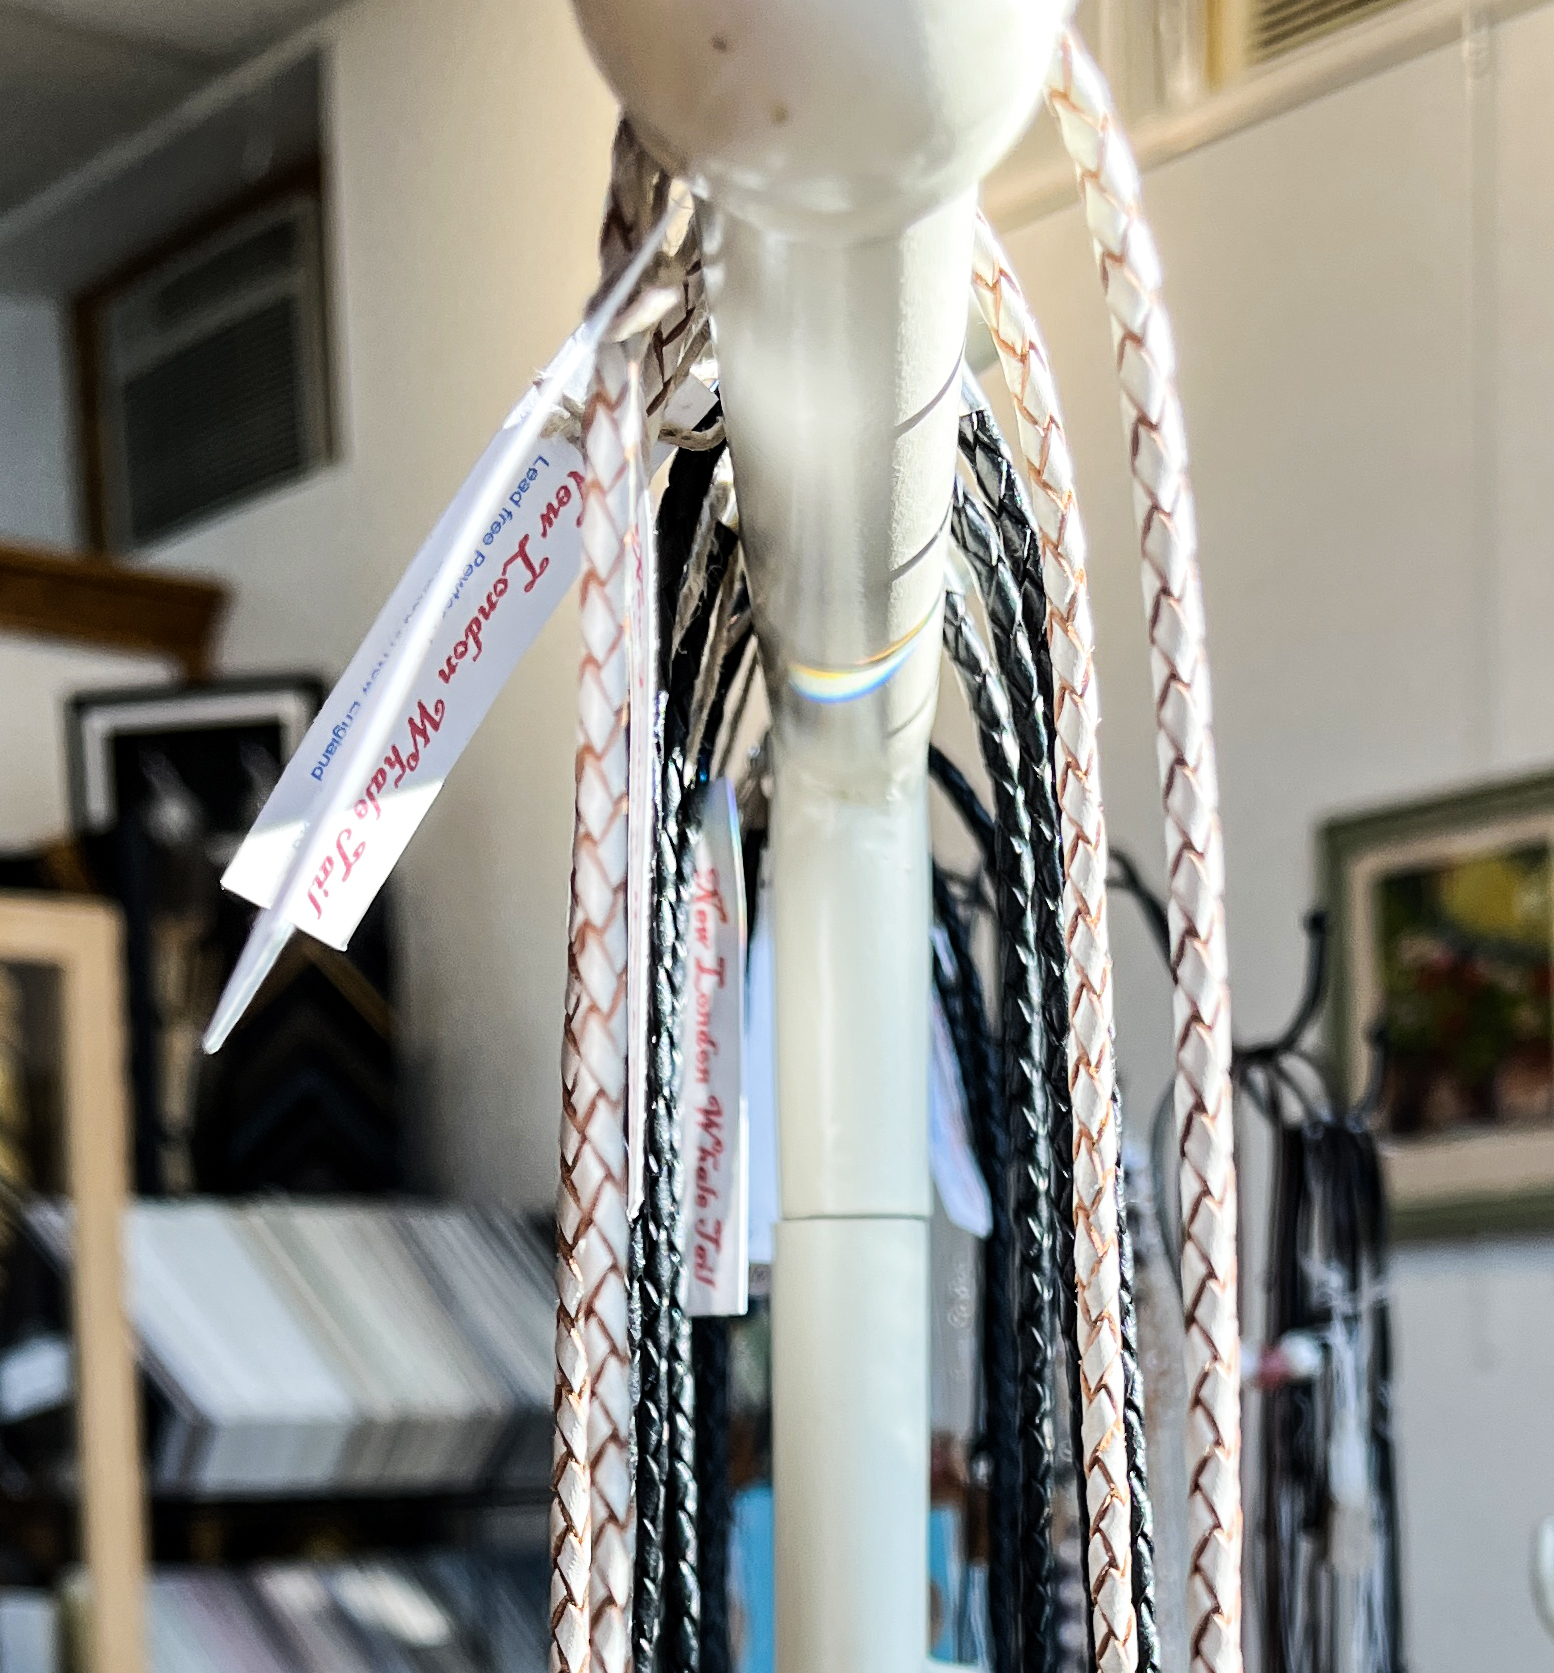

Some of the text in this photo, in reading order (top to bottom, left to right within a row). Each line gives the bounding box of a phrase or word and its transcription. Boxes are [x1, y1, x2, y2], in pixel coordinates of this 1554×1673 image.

[482, 507, 514, 546] free
[509, 454, 550, 508] Lead
[438, 533, 550, 684] London
[353, 698, 446, 820] Whale
[307, 827, 366, 920] Tail
[692, 866, 728, 1290] New London Whale Tail
